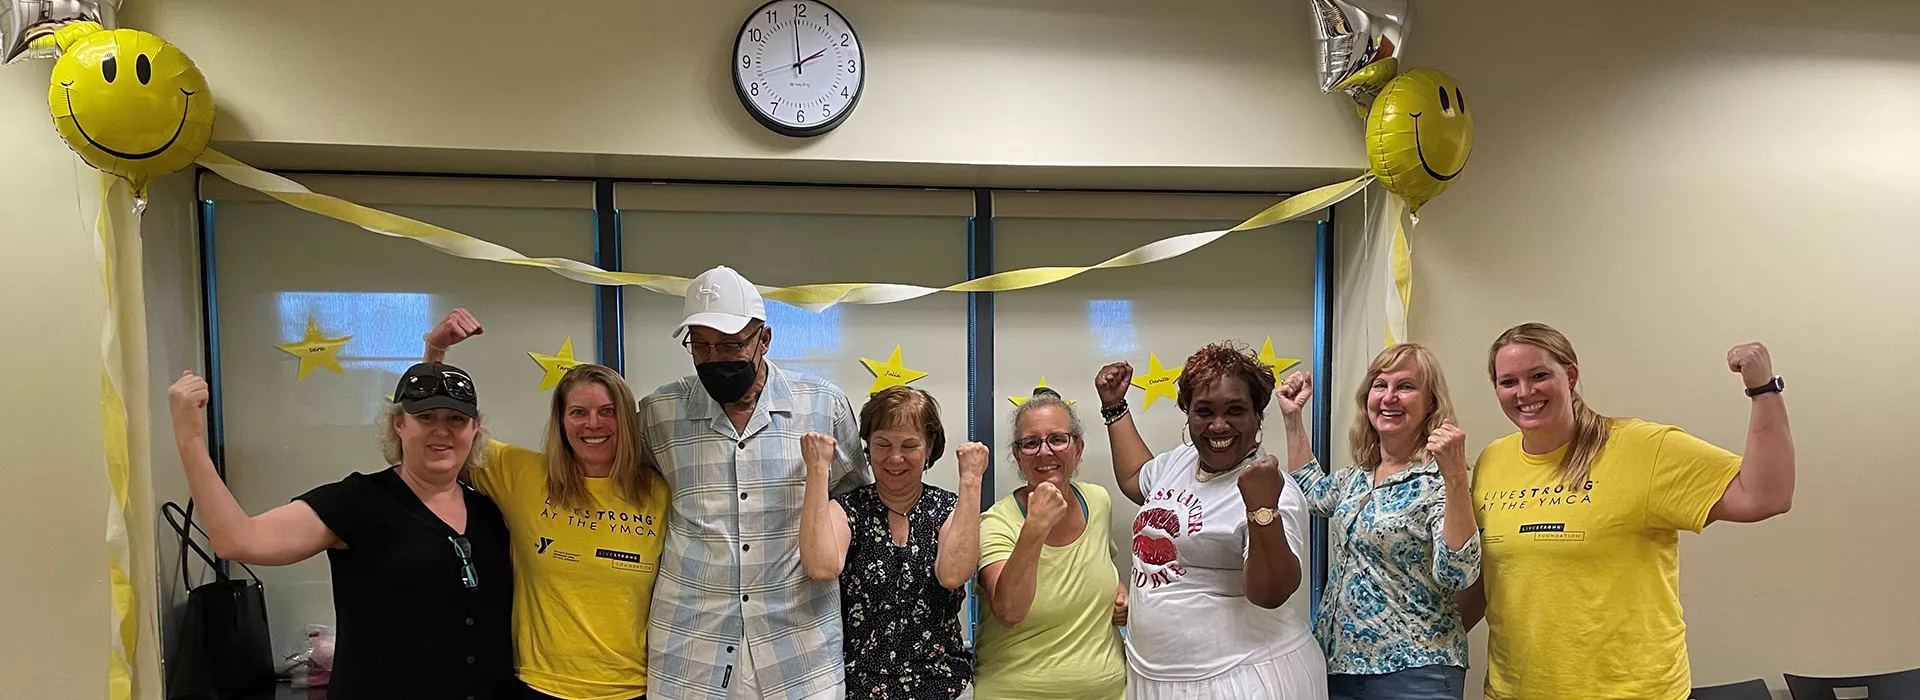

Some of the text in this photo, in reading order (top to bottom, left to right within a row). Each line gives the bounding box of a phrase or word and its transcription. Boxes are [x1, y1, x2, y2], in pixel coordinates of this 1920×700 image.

[766, 10, 777, 24] 11
[793, 4, 807, 18] 12
[824, 13, 830, 26] 1
[748, 28, 762, 42] 10
[841, 33, 849, 47] 2
[742, 55, 751, 69] 9
[847, 60, 856, 73] 3
[750, 82, 759, 96] 8
[840, 86, 849, 99] 4
[770, 102, 779, 115] 7
[822, 104, 831, 118] 5
[796, 110, 805, 123] 6
[1479, 494, 1592, 512] AT THE YMCA
[540, 508, 657, 537] AT THE YMCA
